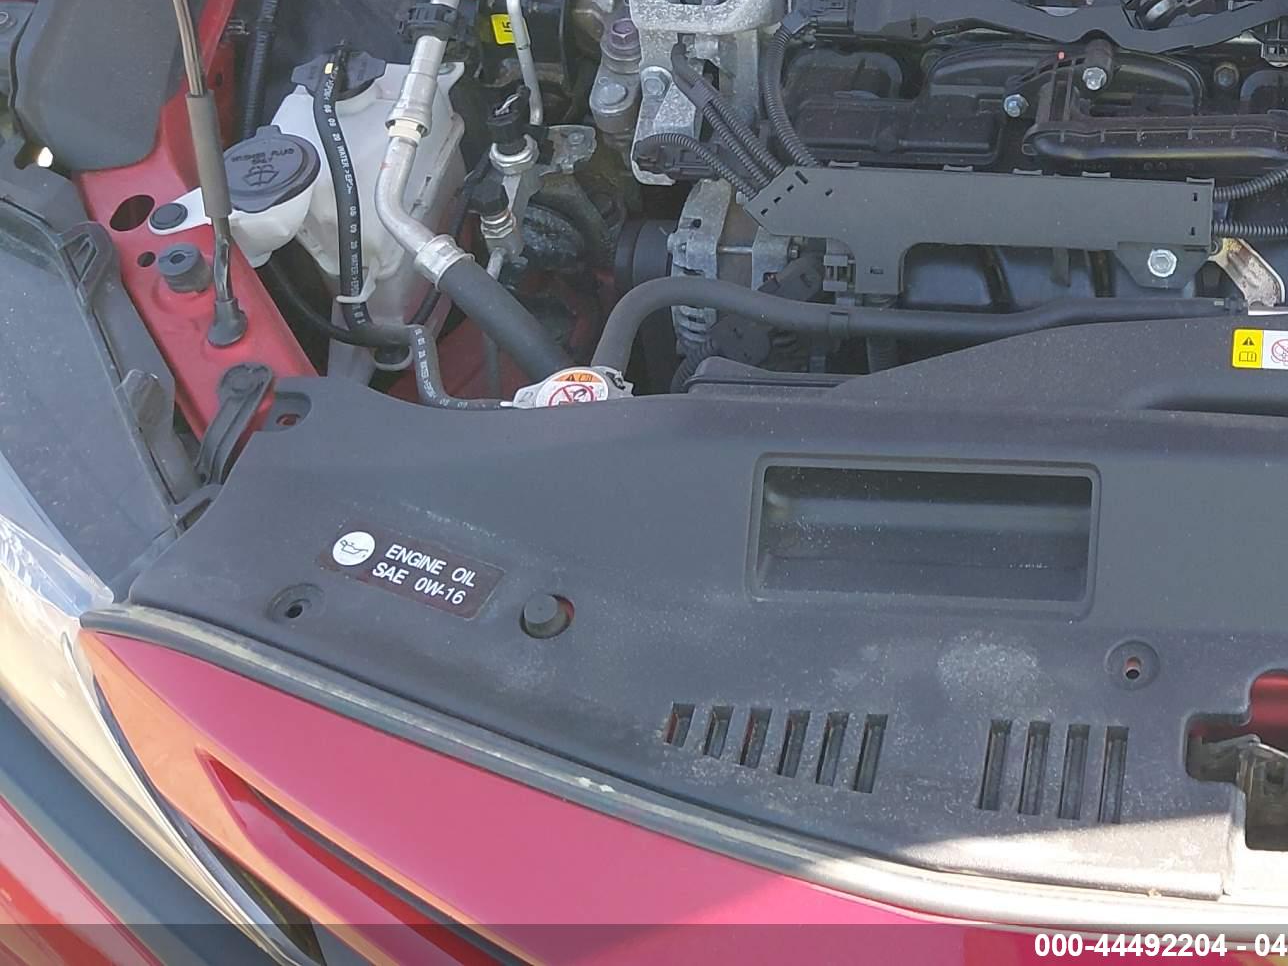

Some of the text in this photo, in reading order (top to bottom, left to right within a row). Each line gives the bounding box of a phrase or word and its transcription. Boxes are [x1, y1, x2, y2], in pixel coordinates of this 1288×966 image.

[336, 145, 350, 168] WATER
[372, 562, 466, 605] SAE 0W-16
[385, 544, 476, 587] ENGINE OIL
